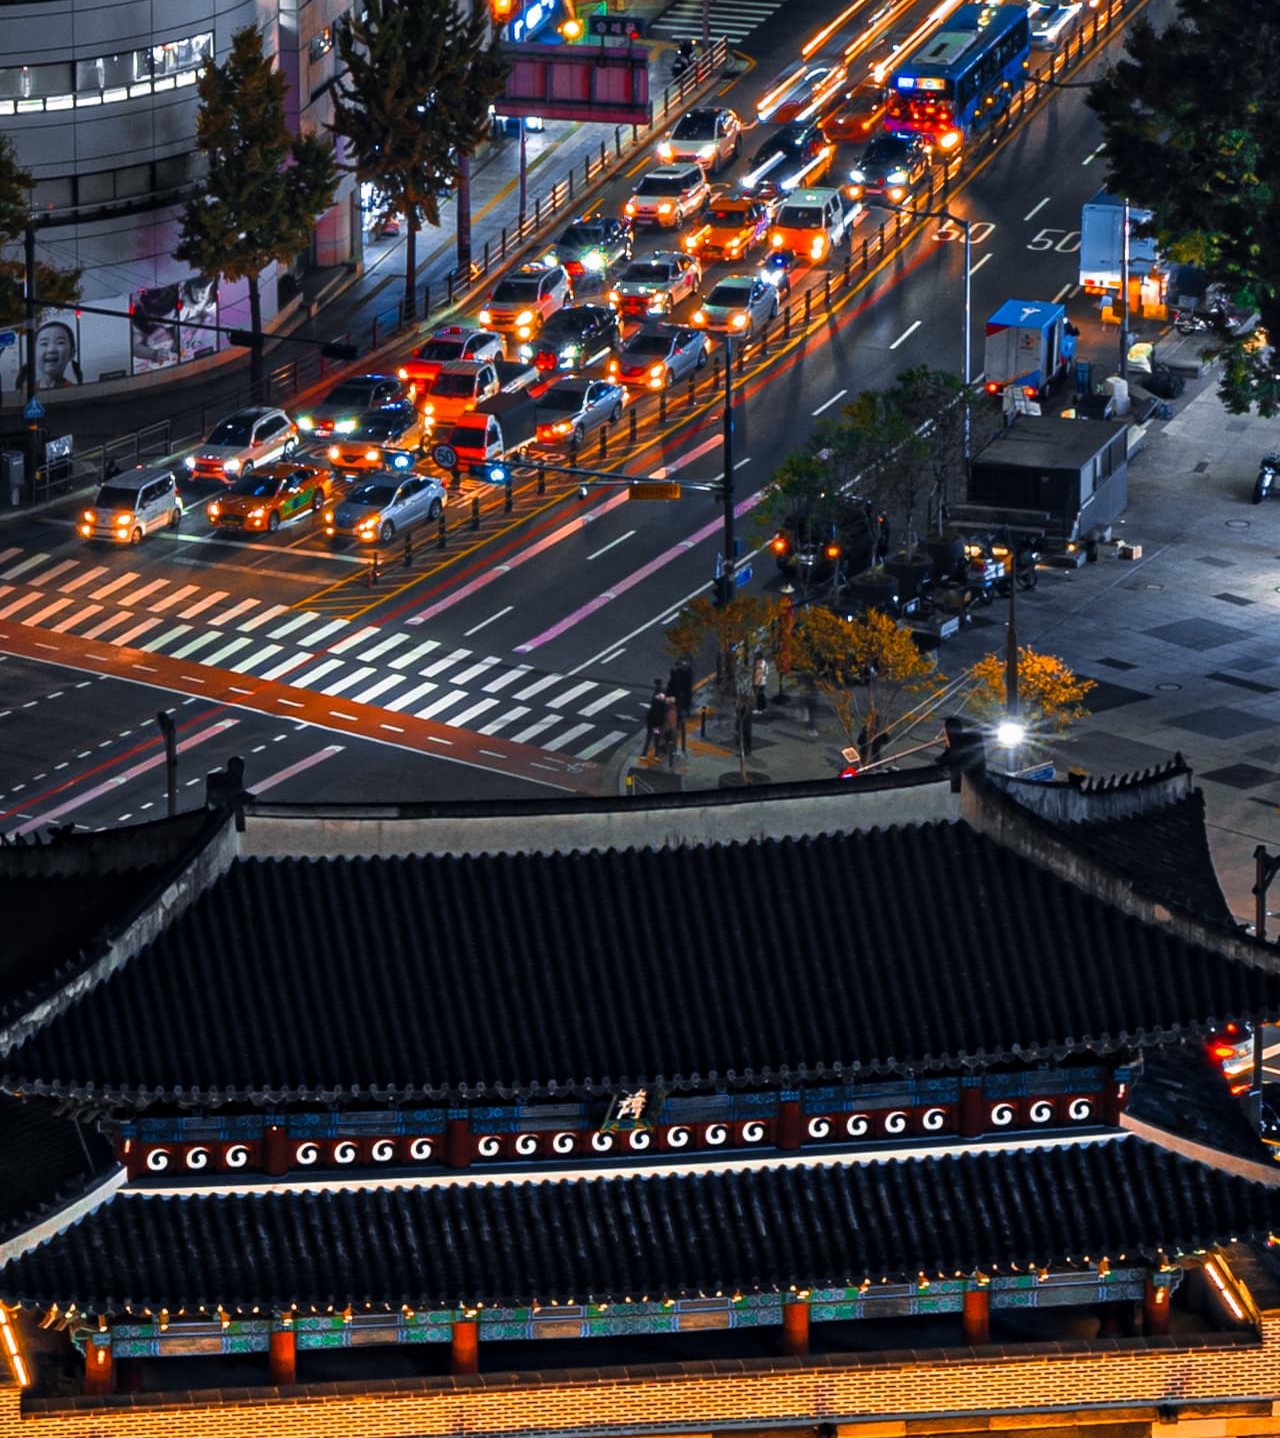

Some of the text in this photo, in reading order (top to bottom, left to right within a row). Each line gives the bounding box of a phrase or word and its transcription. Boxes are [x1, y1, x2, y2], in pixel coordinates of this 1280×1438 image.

[931, 219, 997, 244] 50
[1026, 228, 1082, 253] 50
[437, 449, 454, 465] 50
